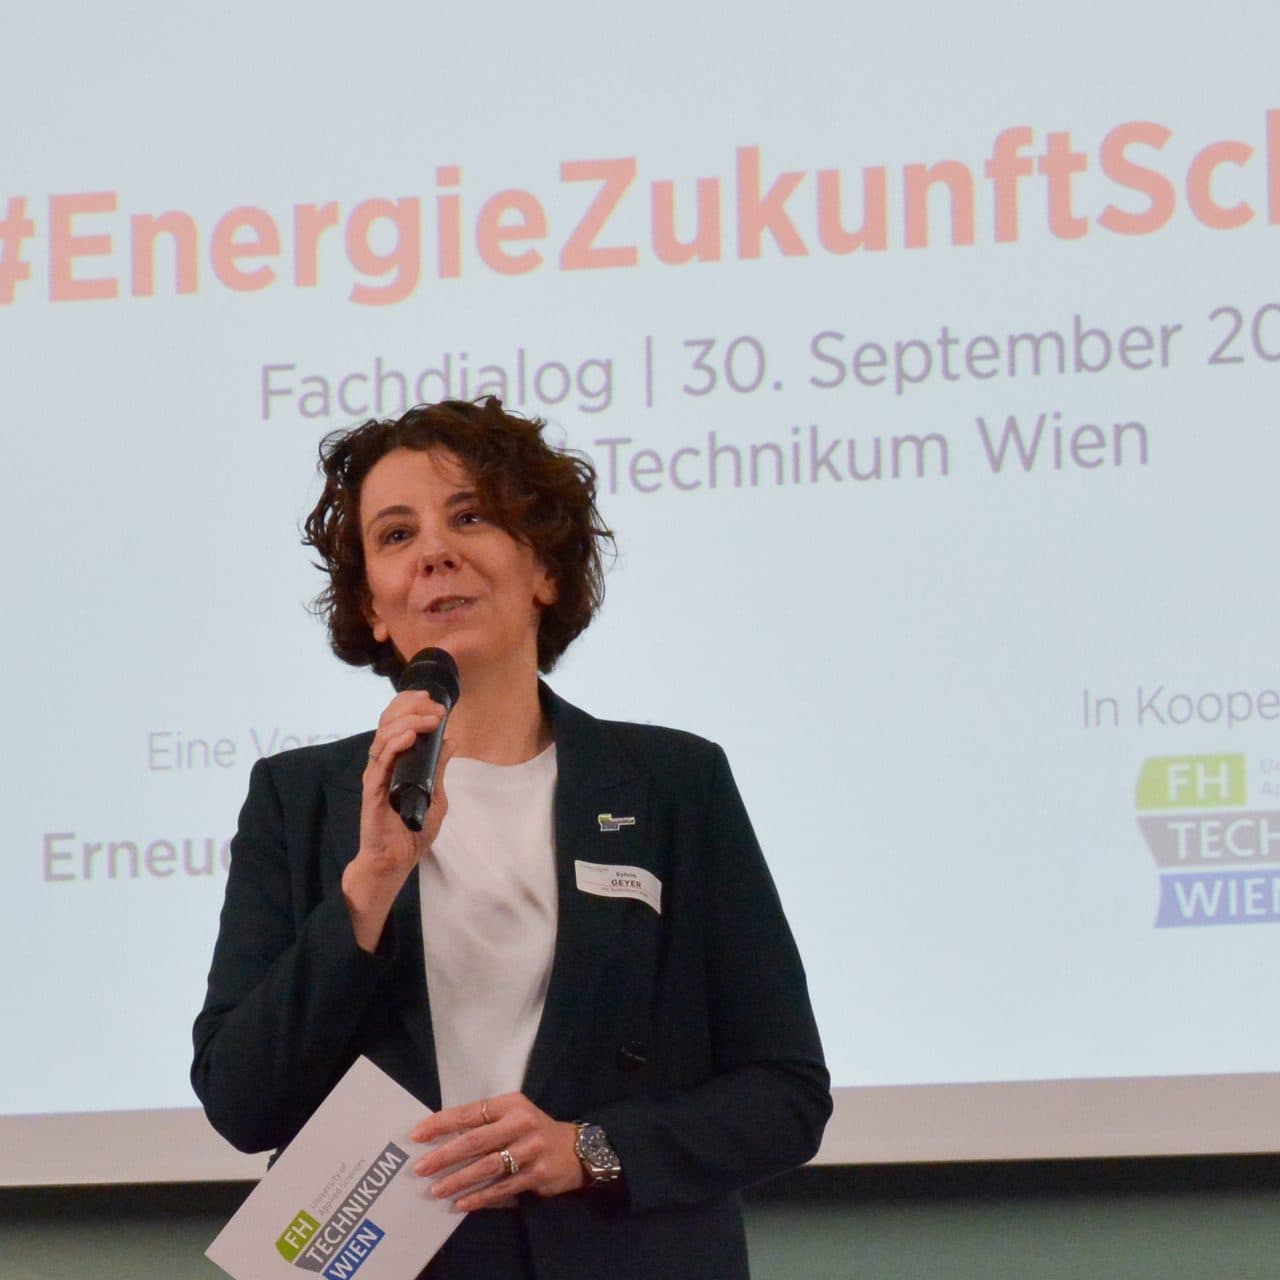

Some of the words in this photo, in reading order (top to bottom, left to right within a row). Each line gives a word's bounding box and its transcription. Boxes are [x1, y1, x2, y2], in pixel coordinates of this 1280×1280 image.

[261, 348, 612, 424] Fachdialog
[683, 337, 783, 396] 30.
[808, 314, 1183, 396] September
[594, 426, 950, 496] Technikum
[976, 411, 1150, 475] Wien
[1083, 688, 1119, 728] In
[147, 731, 236, 771] Eine
[1167, 763, 1229, 800] FH
[611, 880, 641, 888] GEYER
[306, 1151, 401, 1264] TECHNIKUM
[284, 1219, 313, 1250] FH
[328, 1226, 379, 1280] WIEN
